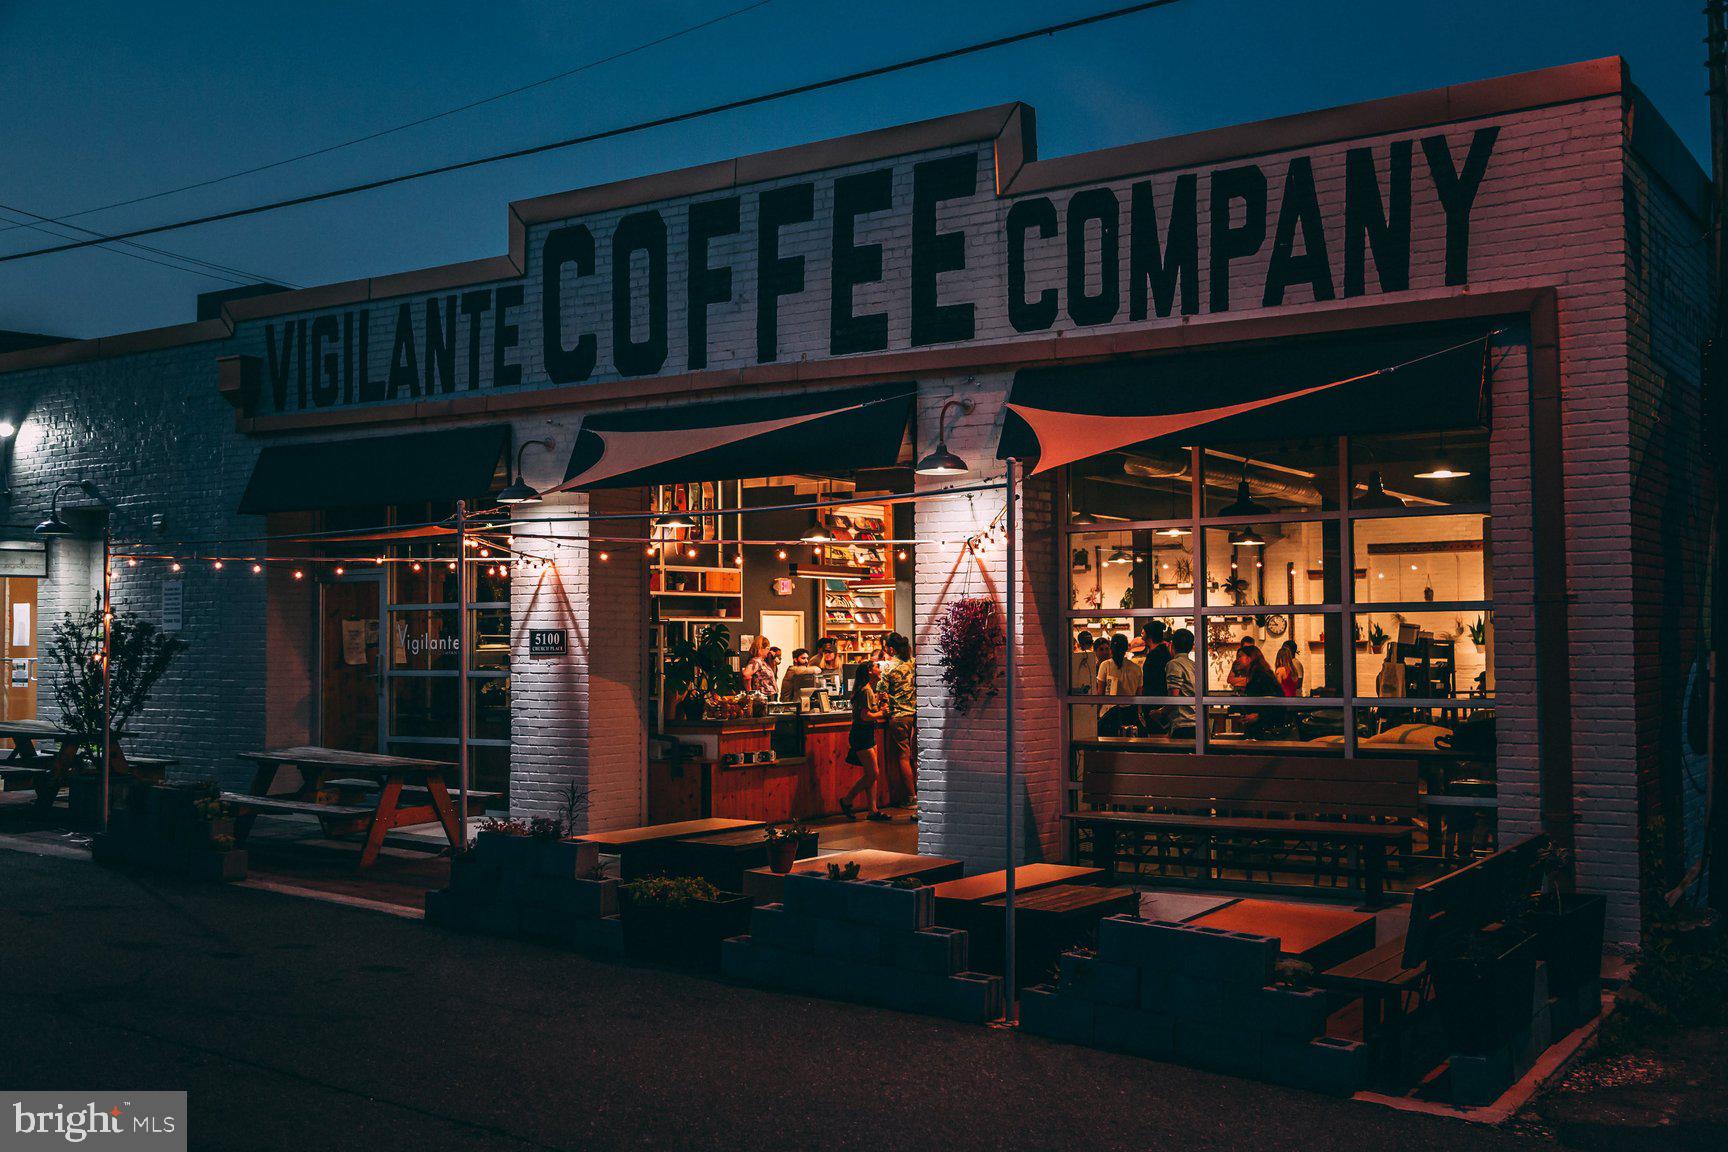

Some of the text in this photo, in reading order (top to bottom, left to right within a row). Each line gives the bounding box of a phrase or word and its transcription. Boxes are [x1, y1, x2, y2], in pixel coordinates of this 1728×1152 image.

[265, 126, 1500, 412] VIGILANTE COFFEE COMPANY
[398, 624, 459, 654] Vigilante
[535, 633, 559, 645] 5100
